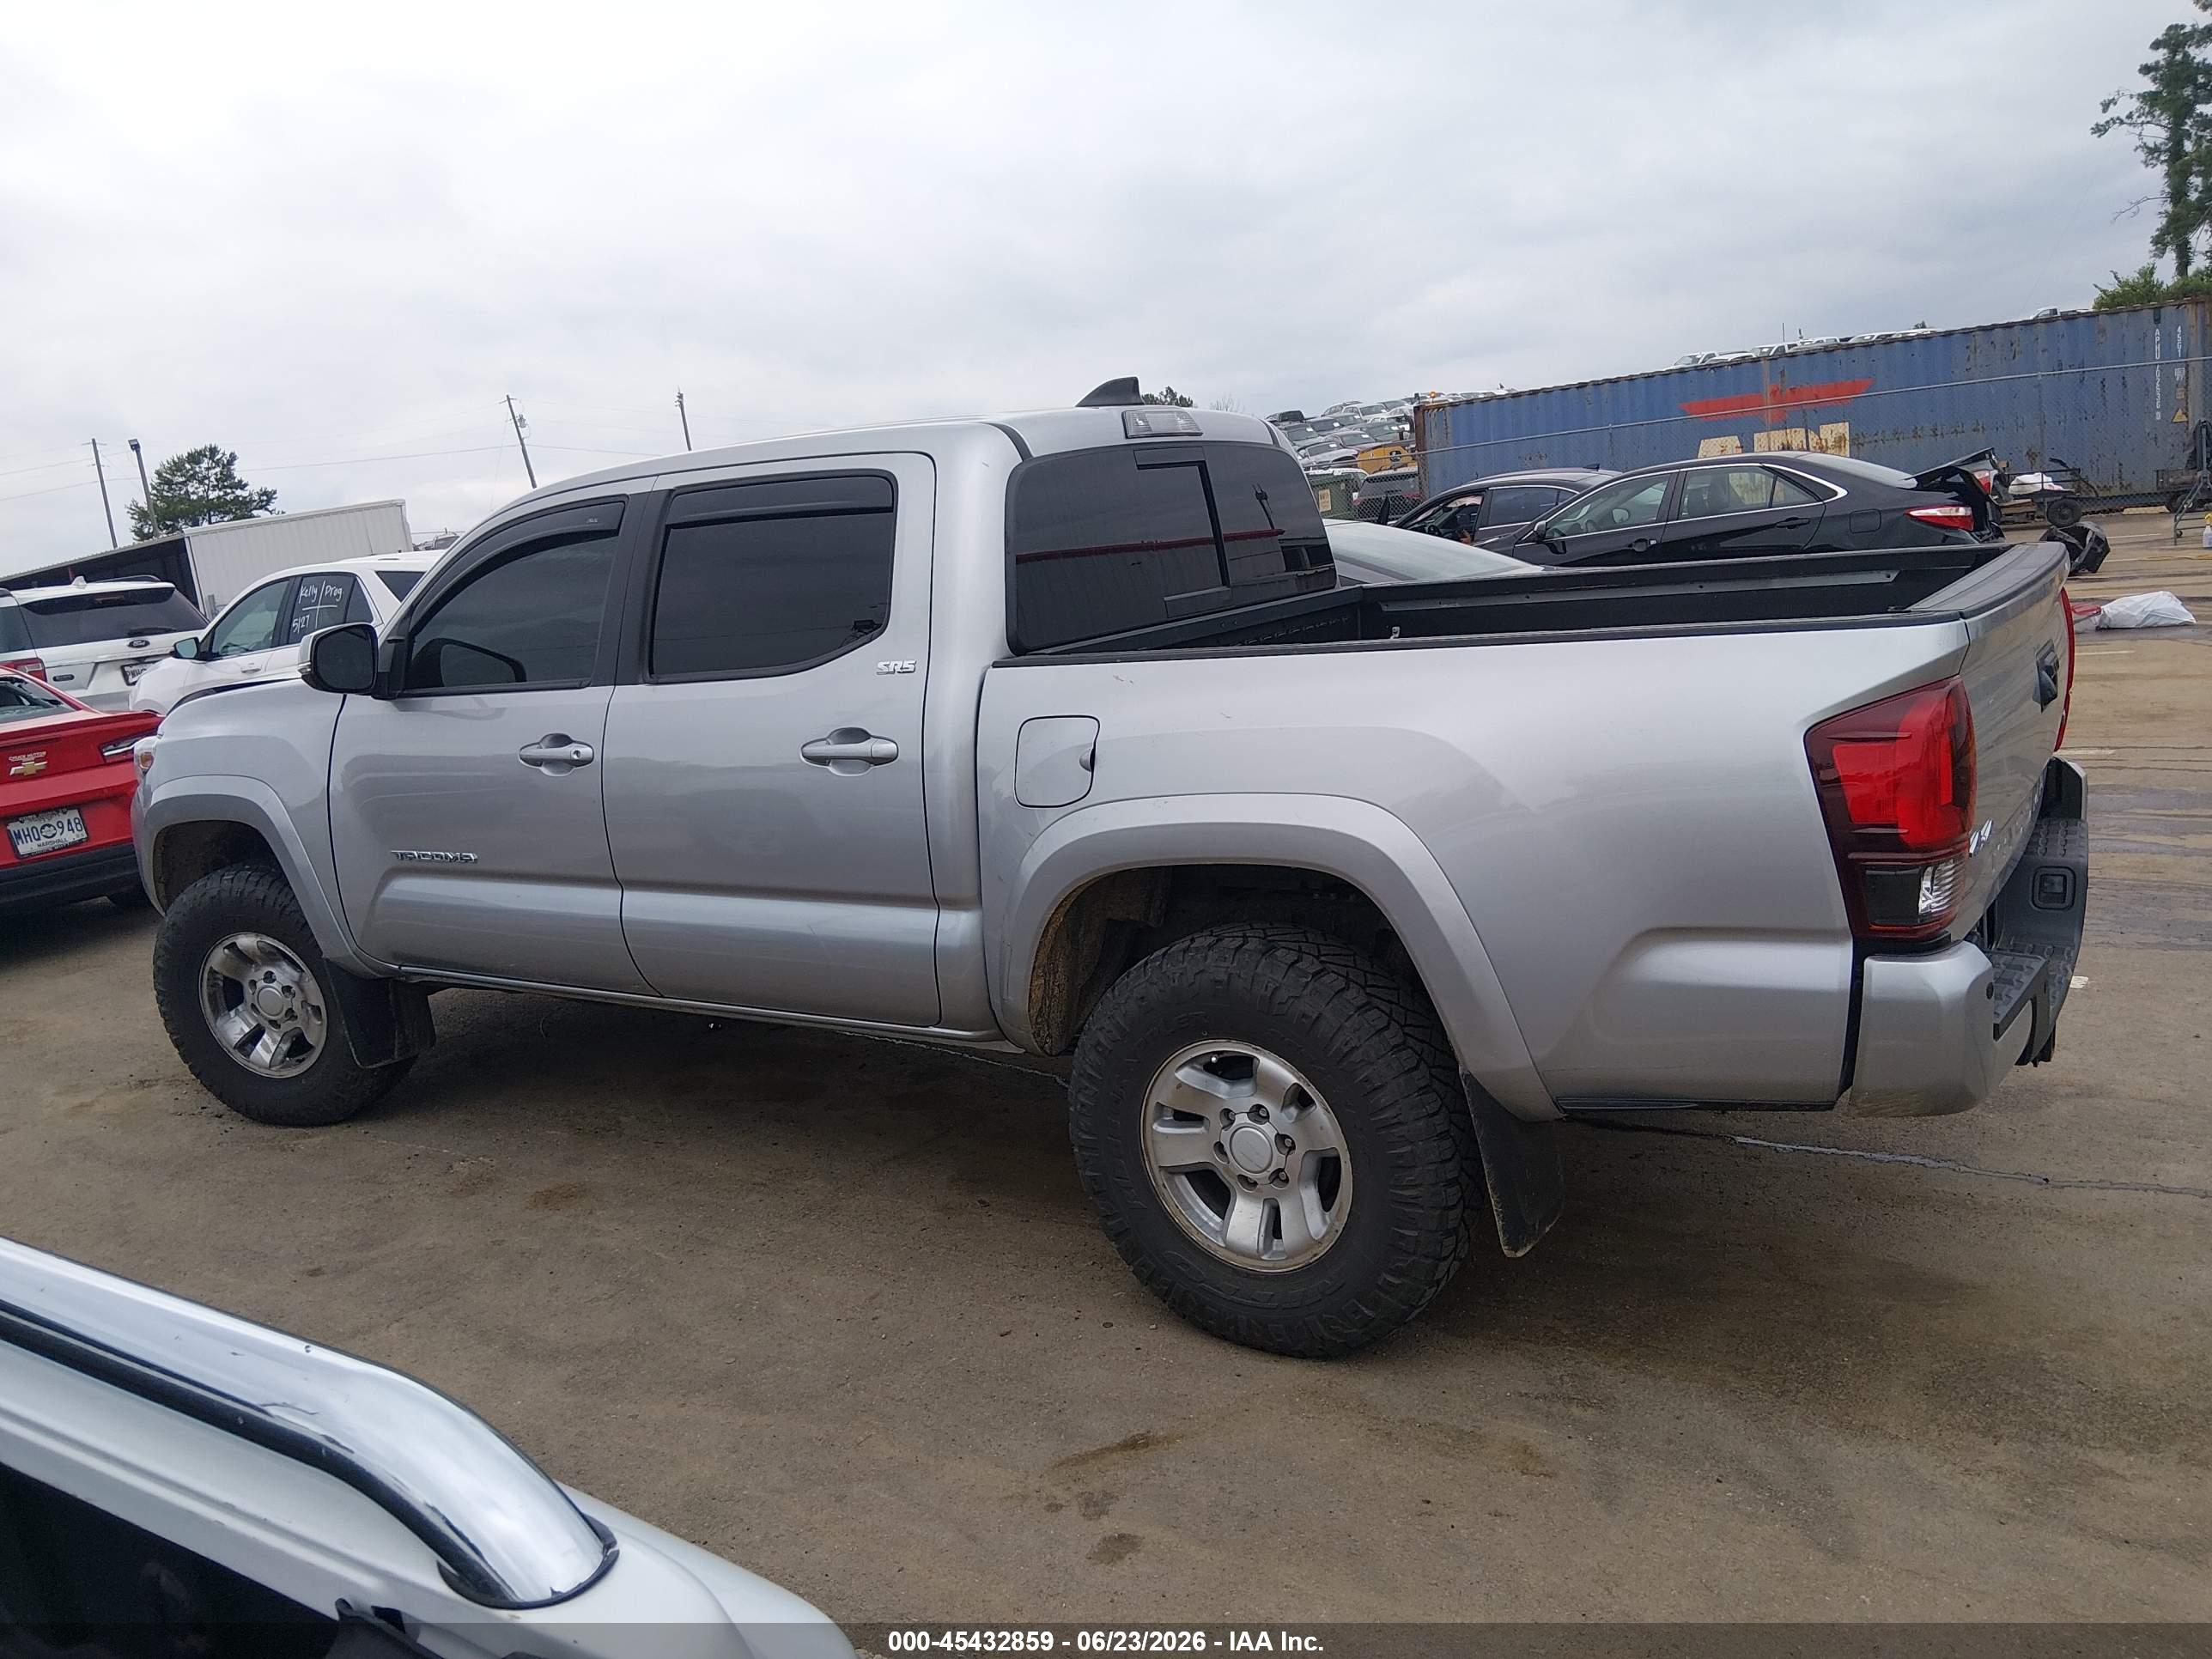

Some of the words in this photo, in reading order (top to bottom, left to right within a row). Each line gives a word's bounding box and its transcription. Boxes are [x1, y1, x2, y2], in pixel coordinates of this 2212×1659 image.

[299, 585, 318, 604] Kelly
[292, 614, 310, 635] 5/27
[876, 660, 917, 675] SR5
[56, 817, 83, 836] 948
[392, 850, 478, 863] TACOMA
